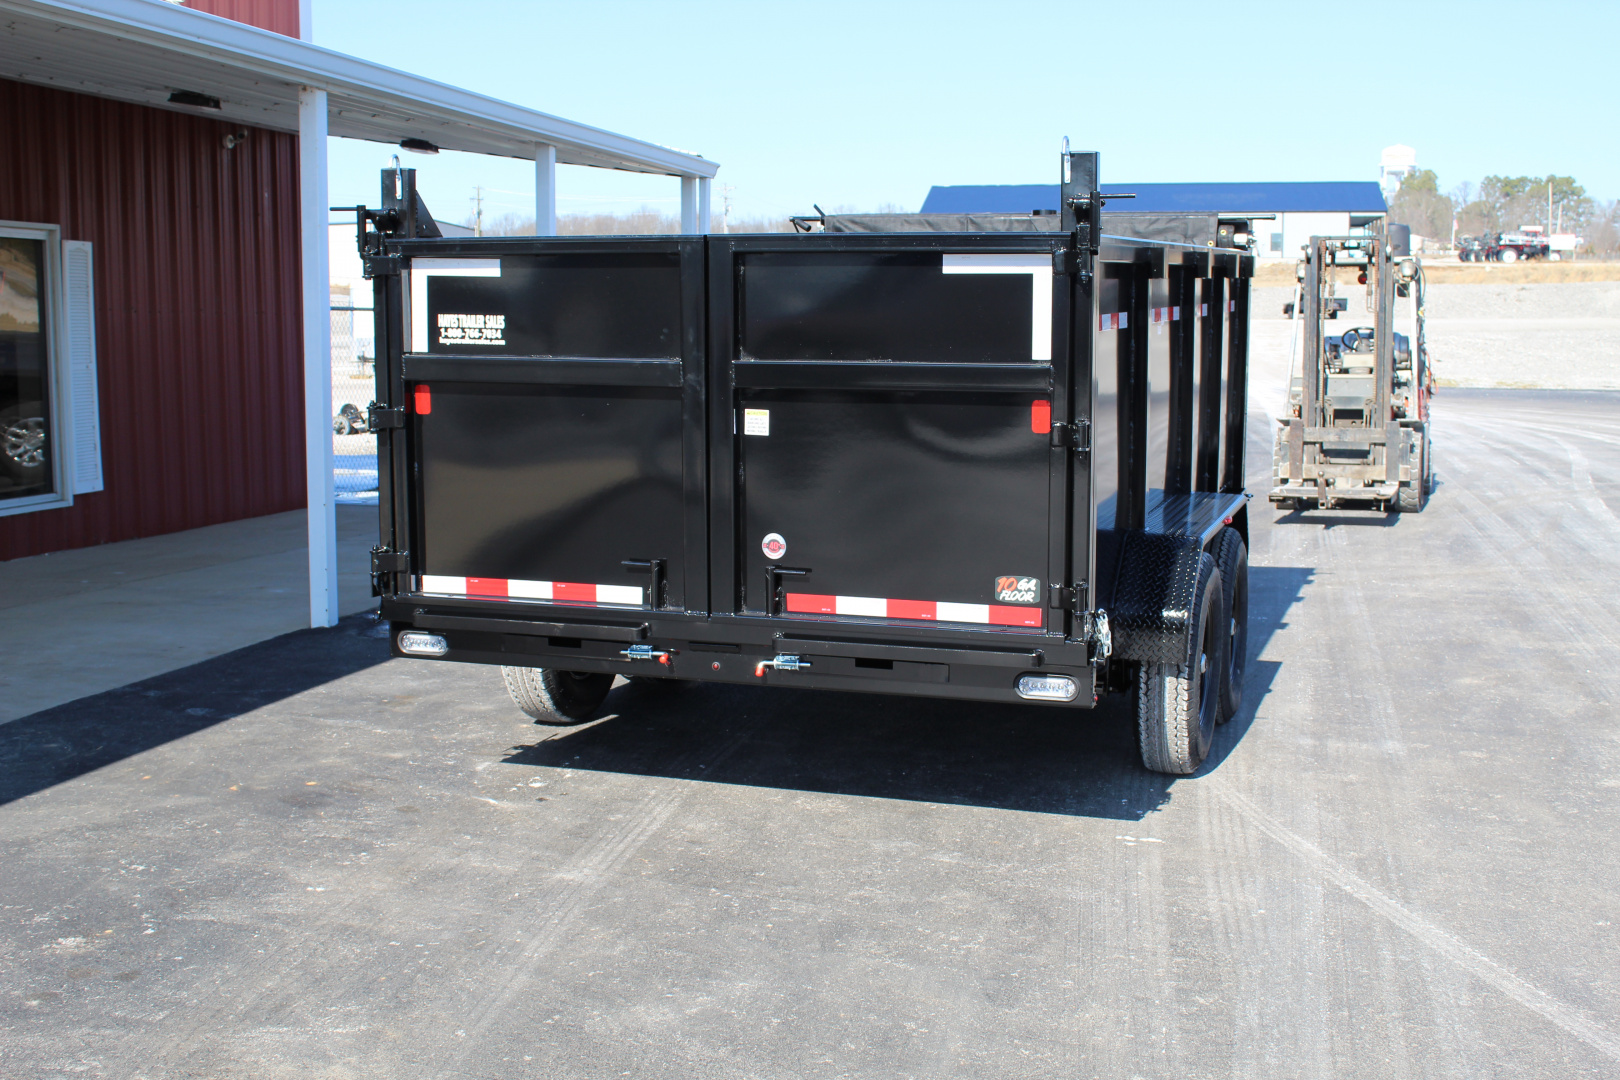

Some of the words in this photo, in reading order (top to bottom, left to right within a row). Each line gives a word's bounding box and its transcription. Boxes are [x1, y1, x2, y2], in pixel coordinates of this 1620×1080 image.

[438, 314, 458, 327] HAYES
[458, 314, 484, 328] TRAILER
[485, 315, 505, 329] SALES
[997, 577, 1018, 592] 10
[999, 590, 1035, 602] FLOOR
